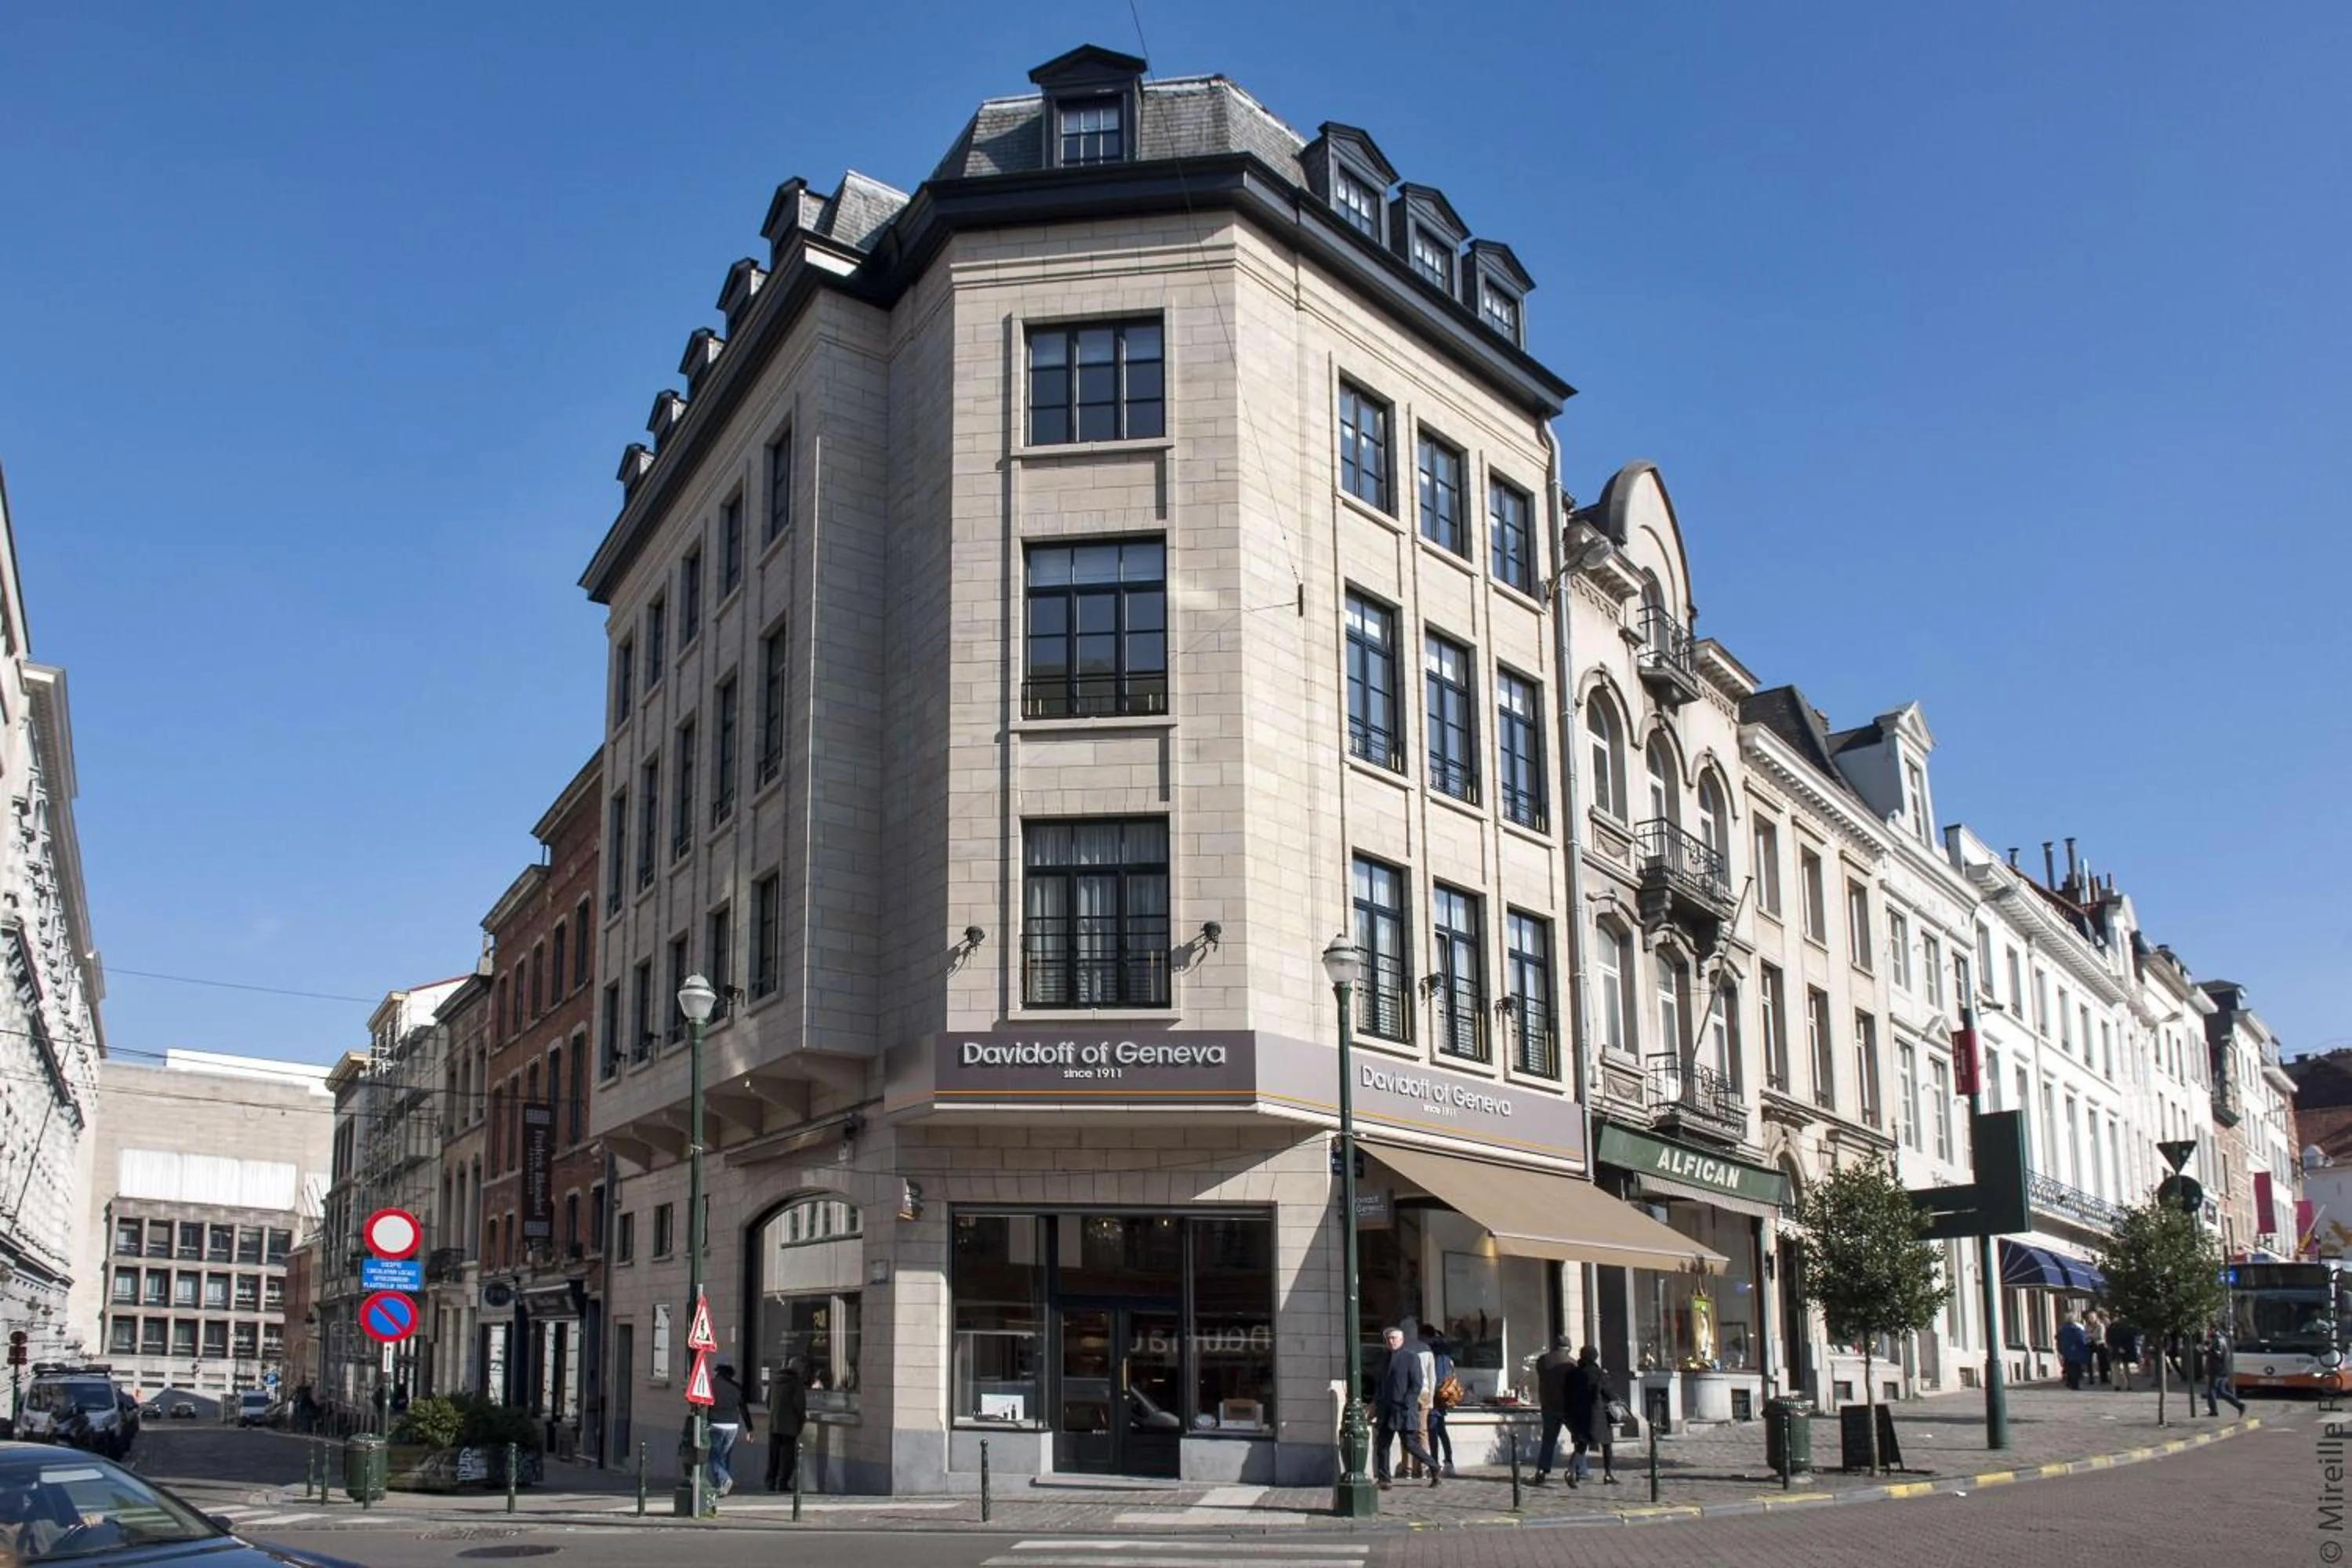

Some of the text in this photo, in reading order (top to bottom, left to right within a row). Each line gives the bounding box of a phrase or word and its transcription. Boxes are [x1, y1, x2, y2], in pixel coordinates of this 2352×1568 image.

[963, 1040, 1226, 1065] Davidoff of Geneva
[1063, 1067, 1122, 1078] since 1911
[1362, 1065, 1512, 1116] Davidoff of Geneva
[1657, 1147, 1740, 1189] ALFICAN
